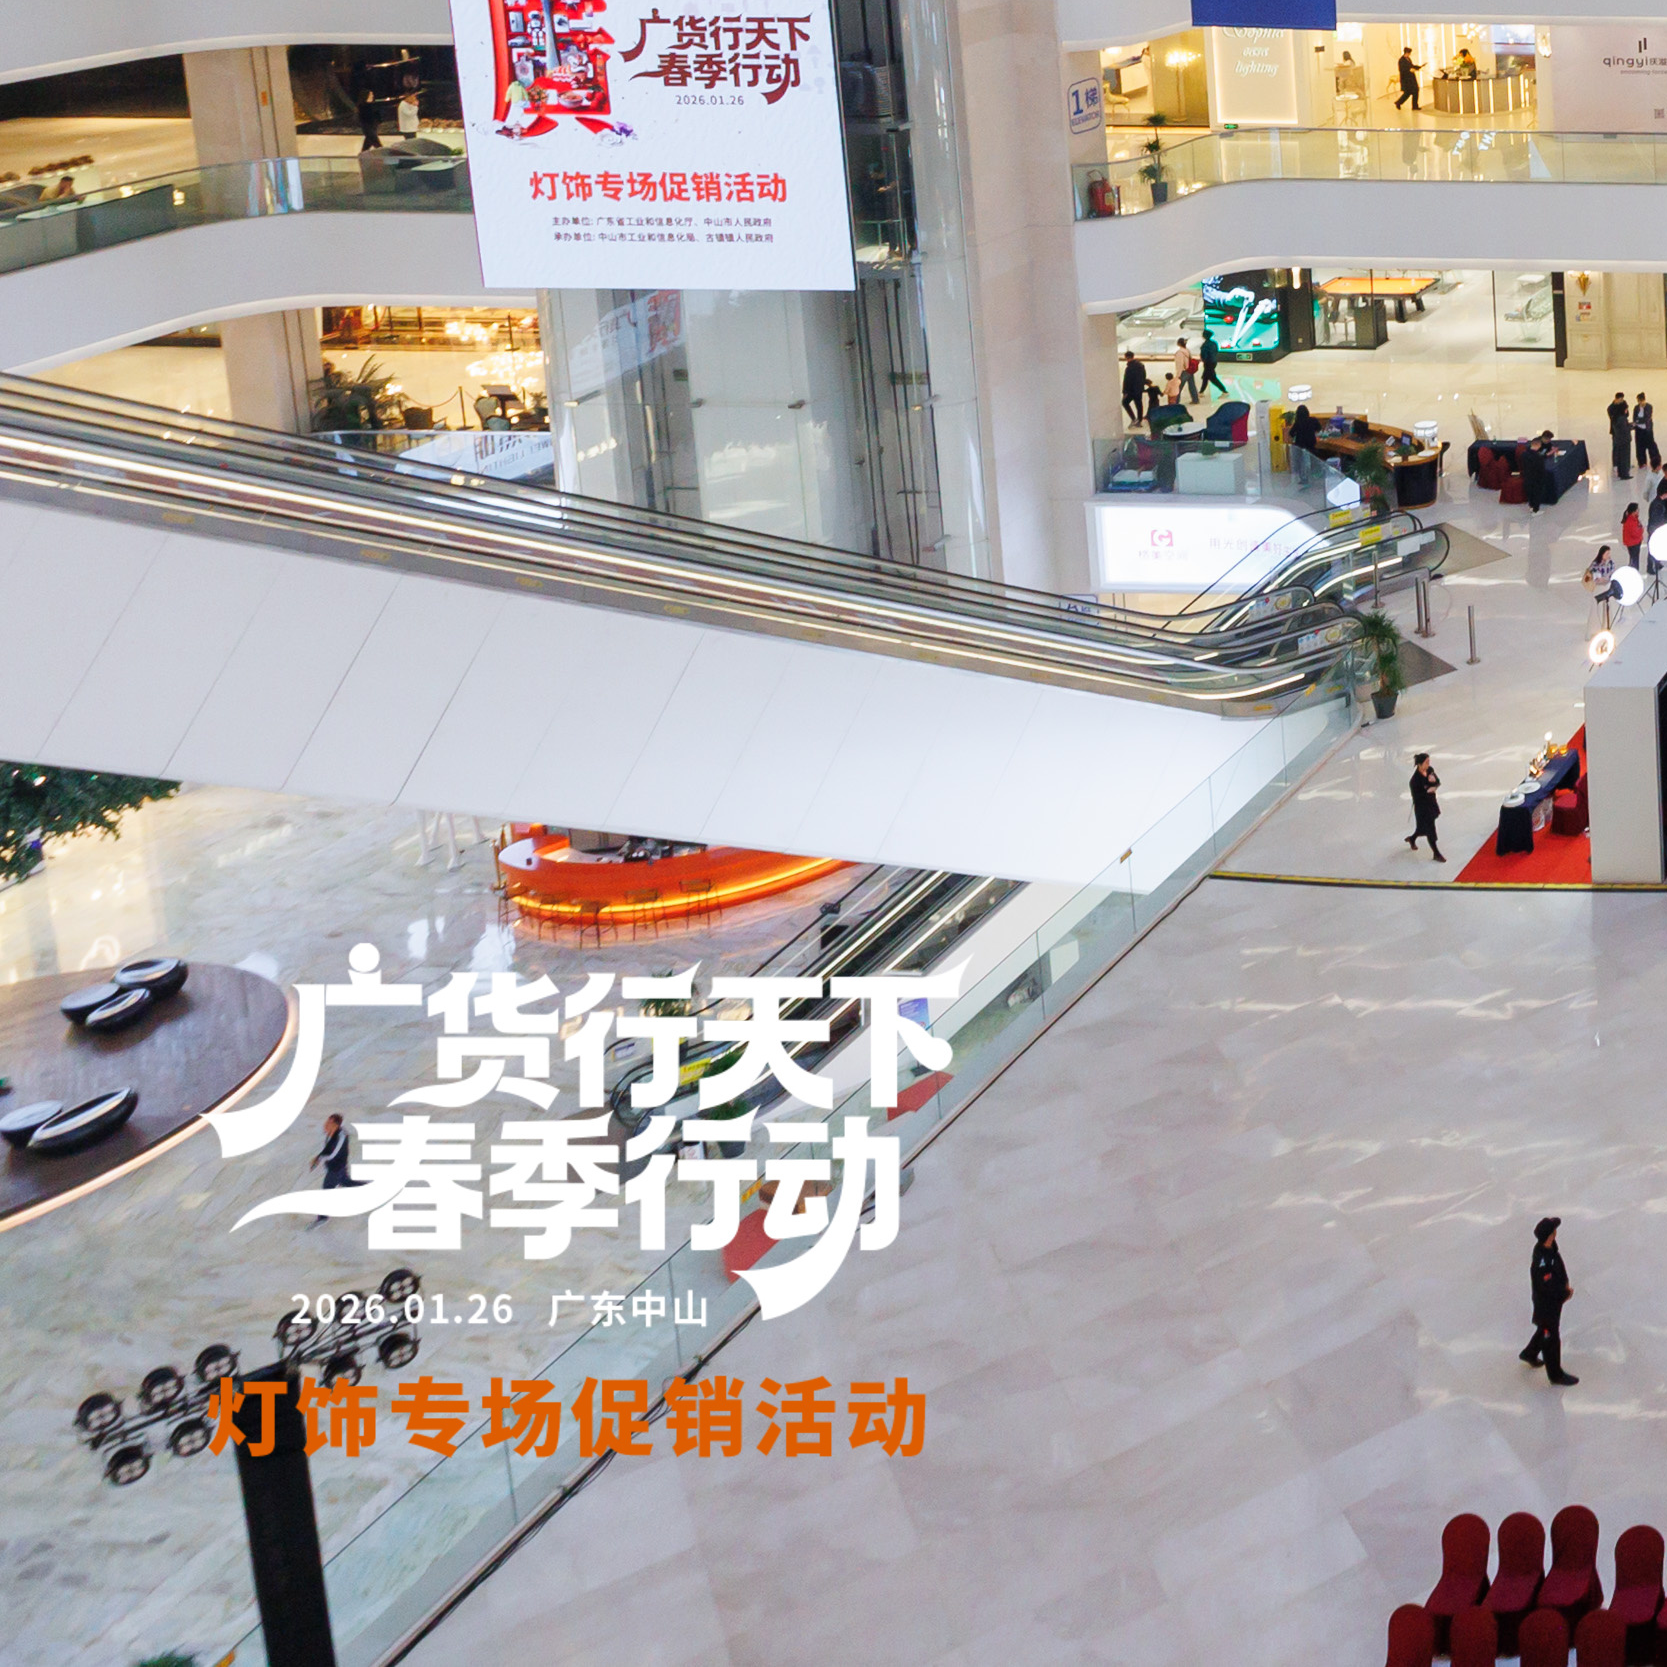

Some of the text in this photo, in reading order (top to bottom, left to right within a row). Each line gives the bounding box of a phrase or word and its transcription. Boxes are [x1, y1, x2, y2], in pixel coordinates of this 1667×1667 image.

[618, 8, 814, 63] 广货行天下
[629, 51, 801, 106] 春季行动
[1603, 56, 1648, 68] qingyi
[675, 95, 745, 108] 2026.01.26
[529, 171, 788, 205] 灯饰专场促销活动
